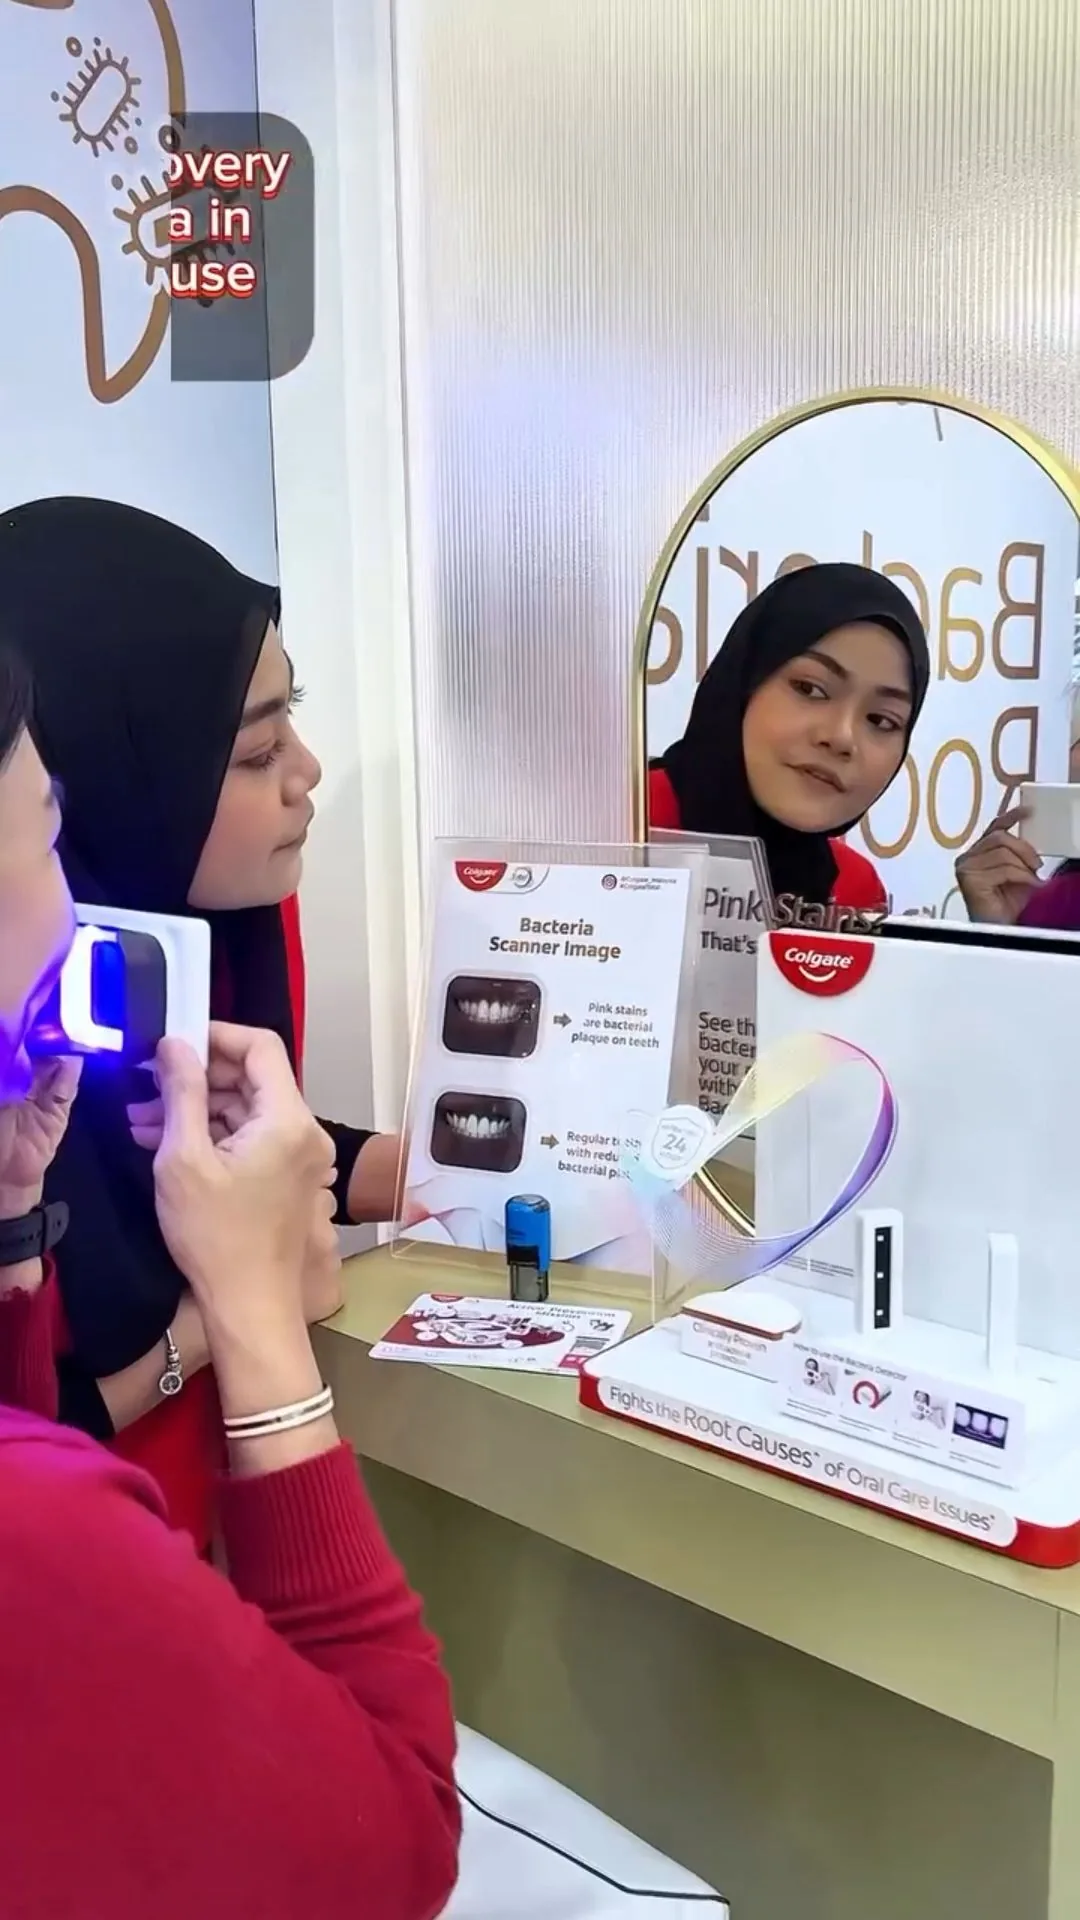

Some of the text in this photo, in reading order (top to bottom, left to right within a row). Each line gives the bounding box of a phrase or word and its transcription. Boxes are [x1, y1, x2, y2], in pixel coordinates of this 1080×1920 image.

[704, 887, 763, 922] Pink
[520, 917, 594, 936] Bacteria
[489, 936, 621, 962] Scanner Image
[700, 931, 757, 954] That's
[784, 947, 854, 968] Colgate
[588, 1002, 648, 1017] Pink stains
[583, 1018, 653, 1032] are bacterial
[698, 1011, 756, 1037] See th
[571, 1031, 660, 1048] plaque on teeth
[698, 1031, 757, 1058] bacter
[698, 1056, 739, 1076] your
[698, 1074, 739, 1096] with
[567, 1131, 609, 1146] Regular
[662, 1134, 687, 1152] 24
[566, 1147, 591, 1159] with
[558, 1161, 606, 1177] bacterial
[692, 1321, 732, 1343] Clinically
[733, 1332, 768, 1353] Proven
[820, 1351, 831, 1360] use
[832, 1352, 845, 1362] the
[846, 1355, 874, 1372] Bacteria
[875, 1365, 908, 1381] Detector
[609, 1386, 654, 1413] Fights
[656, 1402, 681, 1423] the
[683, 1406, 733, 1442] Root
[824, 1461, 845, 1478] of
[847, 1467, 884, 1495] Oral
[887, 1482, 930, 1511] Care
